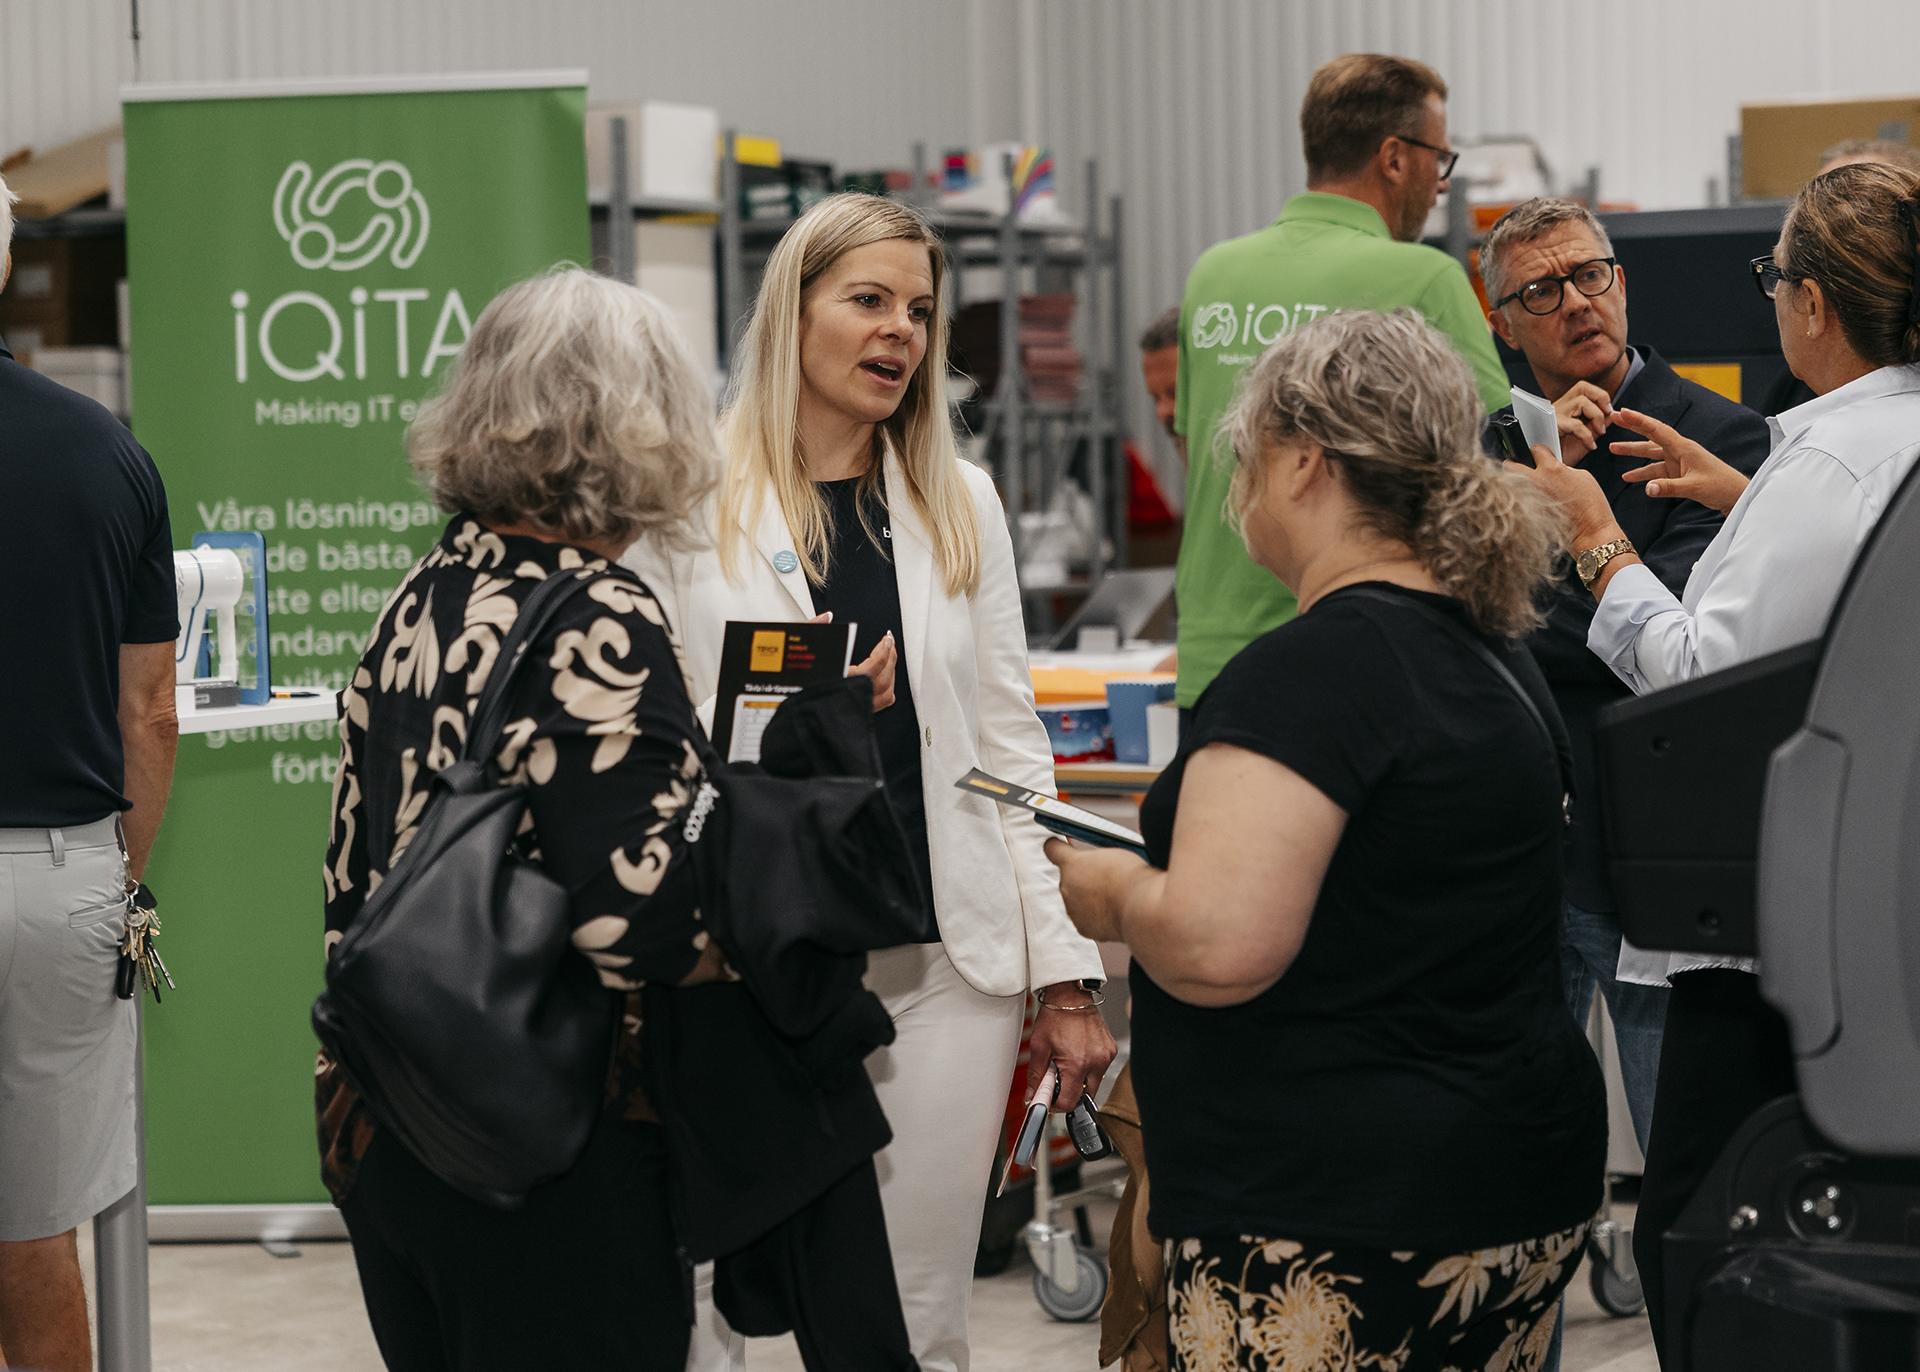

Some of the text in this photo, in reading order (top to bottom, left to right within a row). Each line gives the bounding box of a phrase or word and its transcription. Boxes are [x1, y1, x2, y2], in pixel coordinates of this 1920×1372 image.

[231, 287, 472, 384] iQiTA
[1241, 302, 1341, 346] iQiT
[255, 397, 361, 428] Making
[367, 394, 395, 422] IT
[198, 498, 276, 531] Våra
[317, 539, 413, 572] bästa
